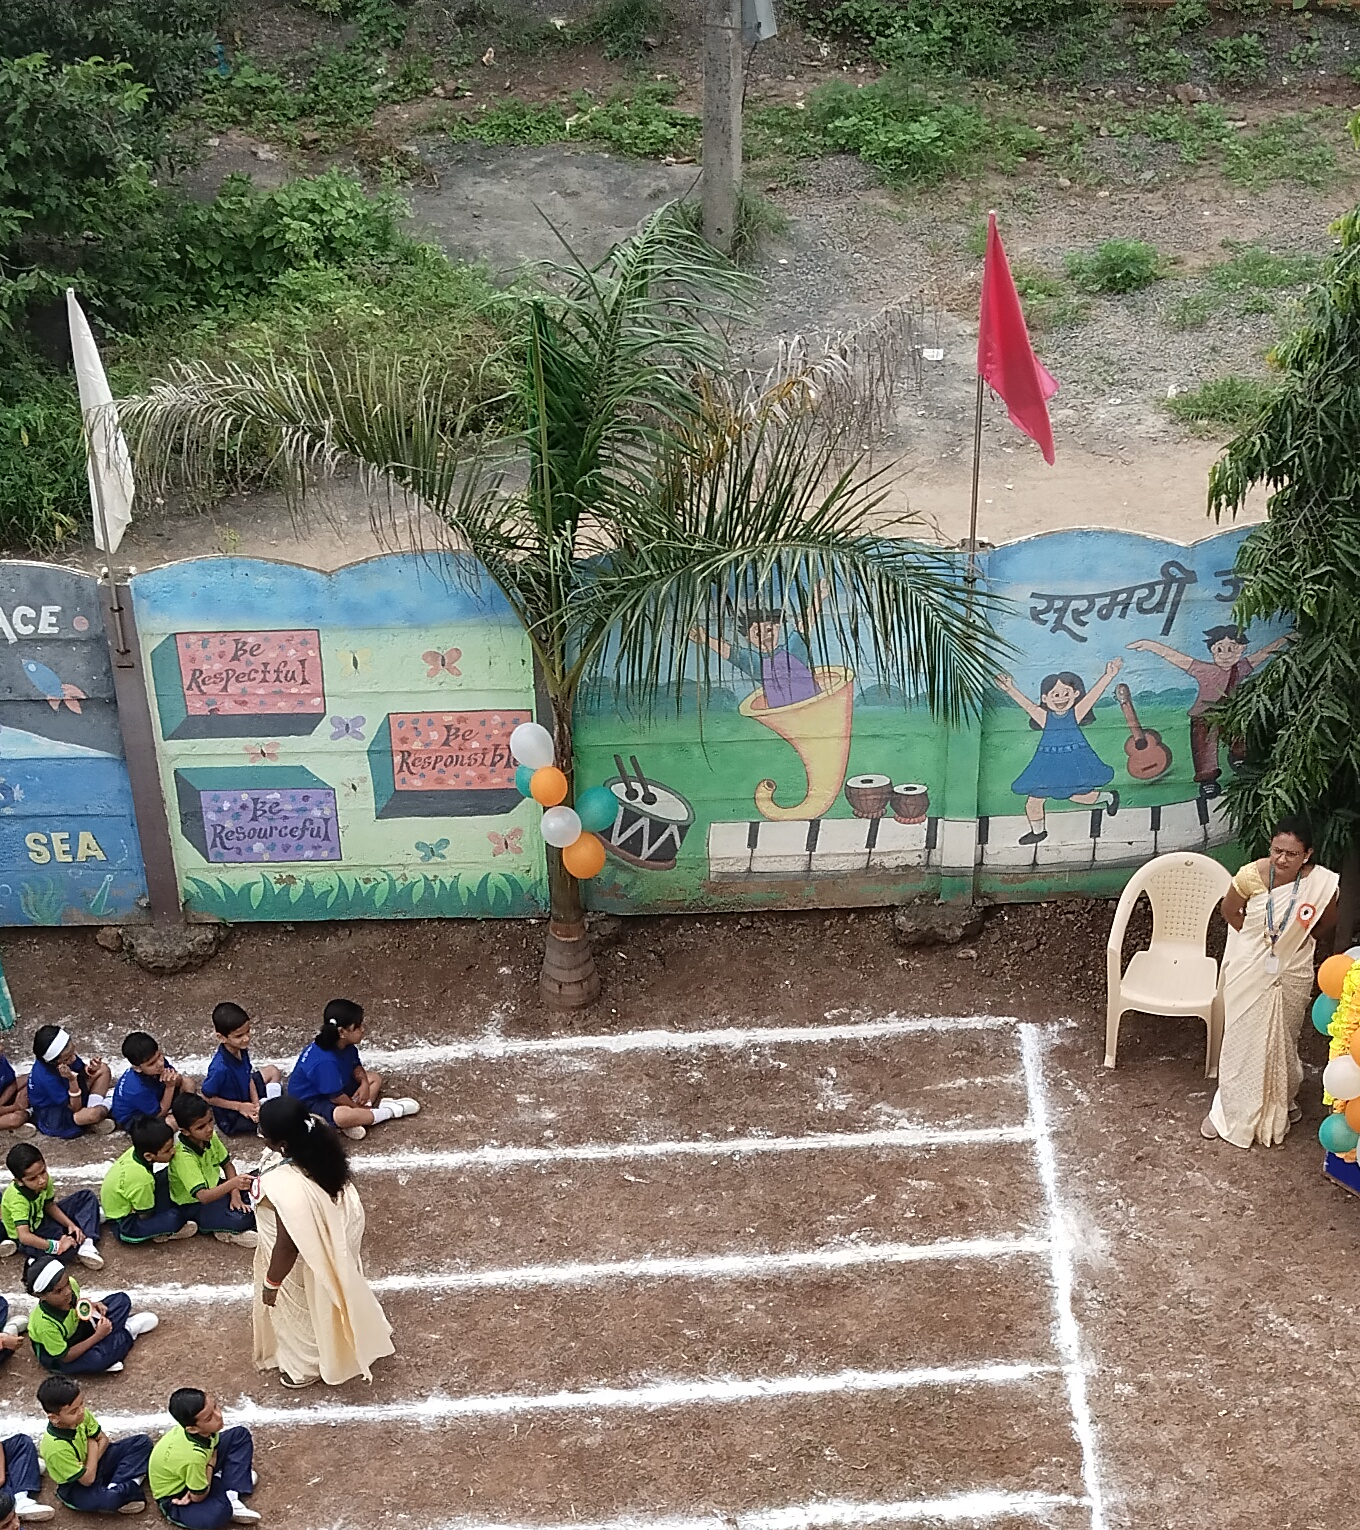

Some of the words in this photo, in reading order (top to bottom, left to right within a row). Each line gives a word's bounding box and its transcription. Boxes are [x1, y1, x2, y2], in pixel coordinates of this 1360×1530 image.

[230, 638, 265, 662] Be
[185, 658, 311, 694] Respectful
[440, 724, 479, 747] Be
[250, 797, 282, 821] Be
[210, 816, 332, 850] Resourceful
[27, 832, 106, 864] SEA
